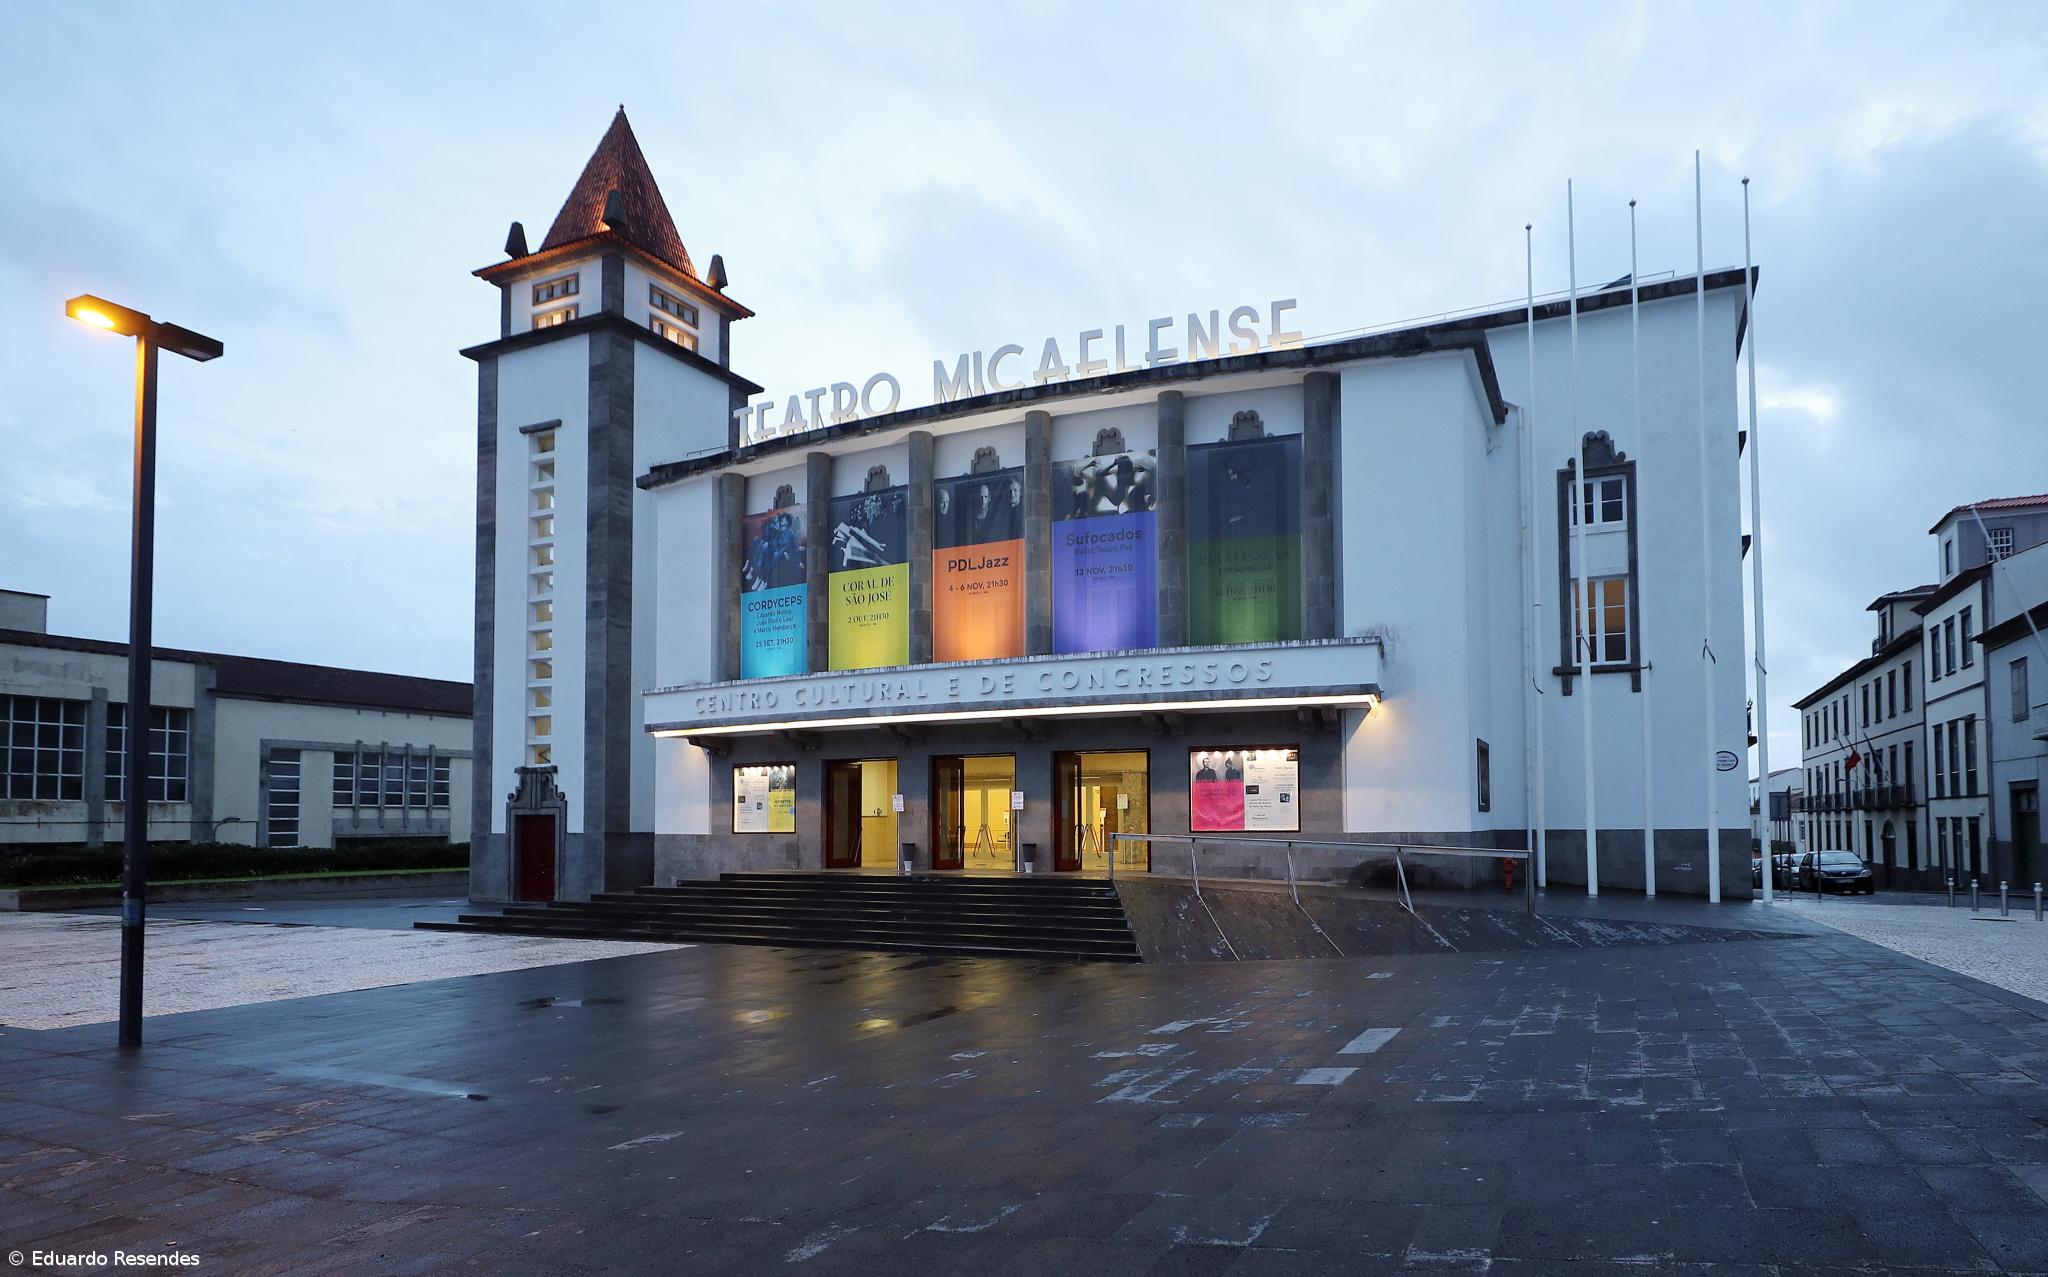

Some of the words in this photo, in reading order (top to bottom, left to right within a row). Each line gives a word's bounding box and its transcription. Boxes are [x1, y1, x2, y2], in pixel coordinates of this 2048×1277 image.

[733, 372, 901, 448] TEATRO
[933, 298, 1303, 404] MICAELENSE
[1066, 528, 1142, 546] Sufocados
[948, 556, 1009, 573] PDLJazz
[842, 578, 878, 593] CORAL
[881, 575, 895, 587] DE
[748, 595, 802, 612] CORDYCEPS
[845, 592, 865, 606] SÃO
[867, 588, 892, 606] JOSÉ
[696, 690, 778, 714] CENTRO
[796, 678, 927, 706] CULTURAL
[948, 676, 960, 697] E
[980, 672, 1015, 695] DE
[1038, 658, 1273, 691] CONGRESSOS
